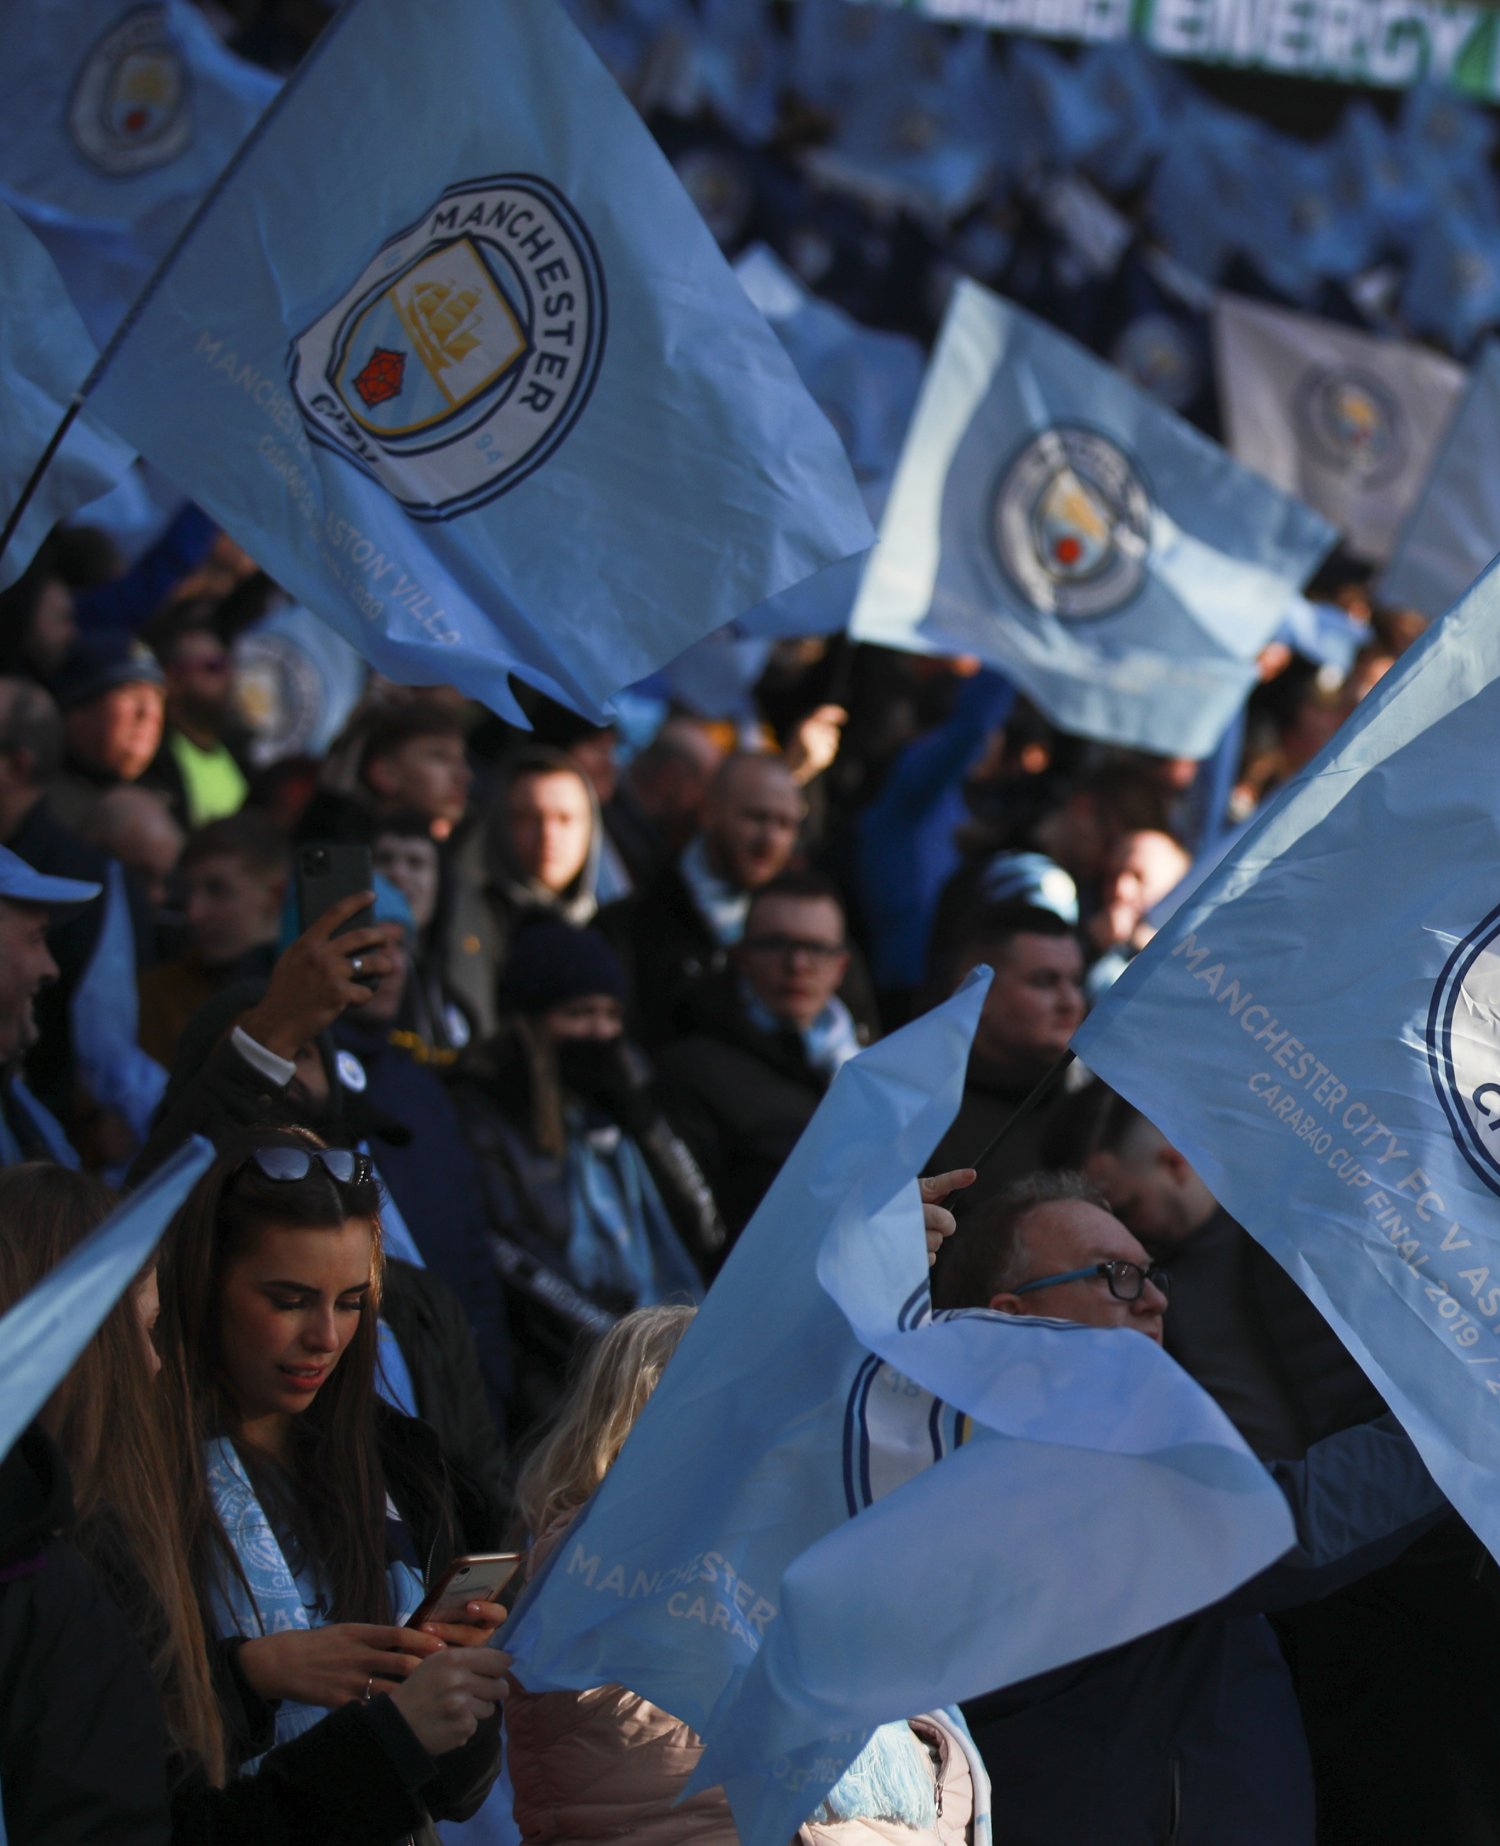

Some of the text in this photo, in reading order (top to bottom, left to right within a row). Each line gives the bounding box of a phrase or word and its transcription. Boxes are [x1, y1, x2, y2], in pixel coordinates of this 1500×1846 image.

[1150, 0, 1481, 88] ENERGY
[430, 201, 575, 414] MANCHESTER
[1171, 933, 1348, 1114] MANCHESTER
[1342, 1102, 1409, 1165] CITY
[1396, 1168, 1445, 1222] FC
[1439, 1222, 1471, 1253] V
[1249, 1072, 1332, 1155] CARABAO
[1327, 1148, 1372, 1188] CUP
[1364, 1189, 1431, 1279] FINAL
[1424, 1279, 1480, 1348] 2019
[566, 1544, 778, 1635] MANCHESTER
